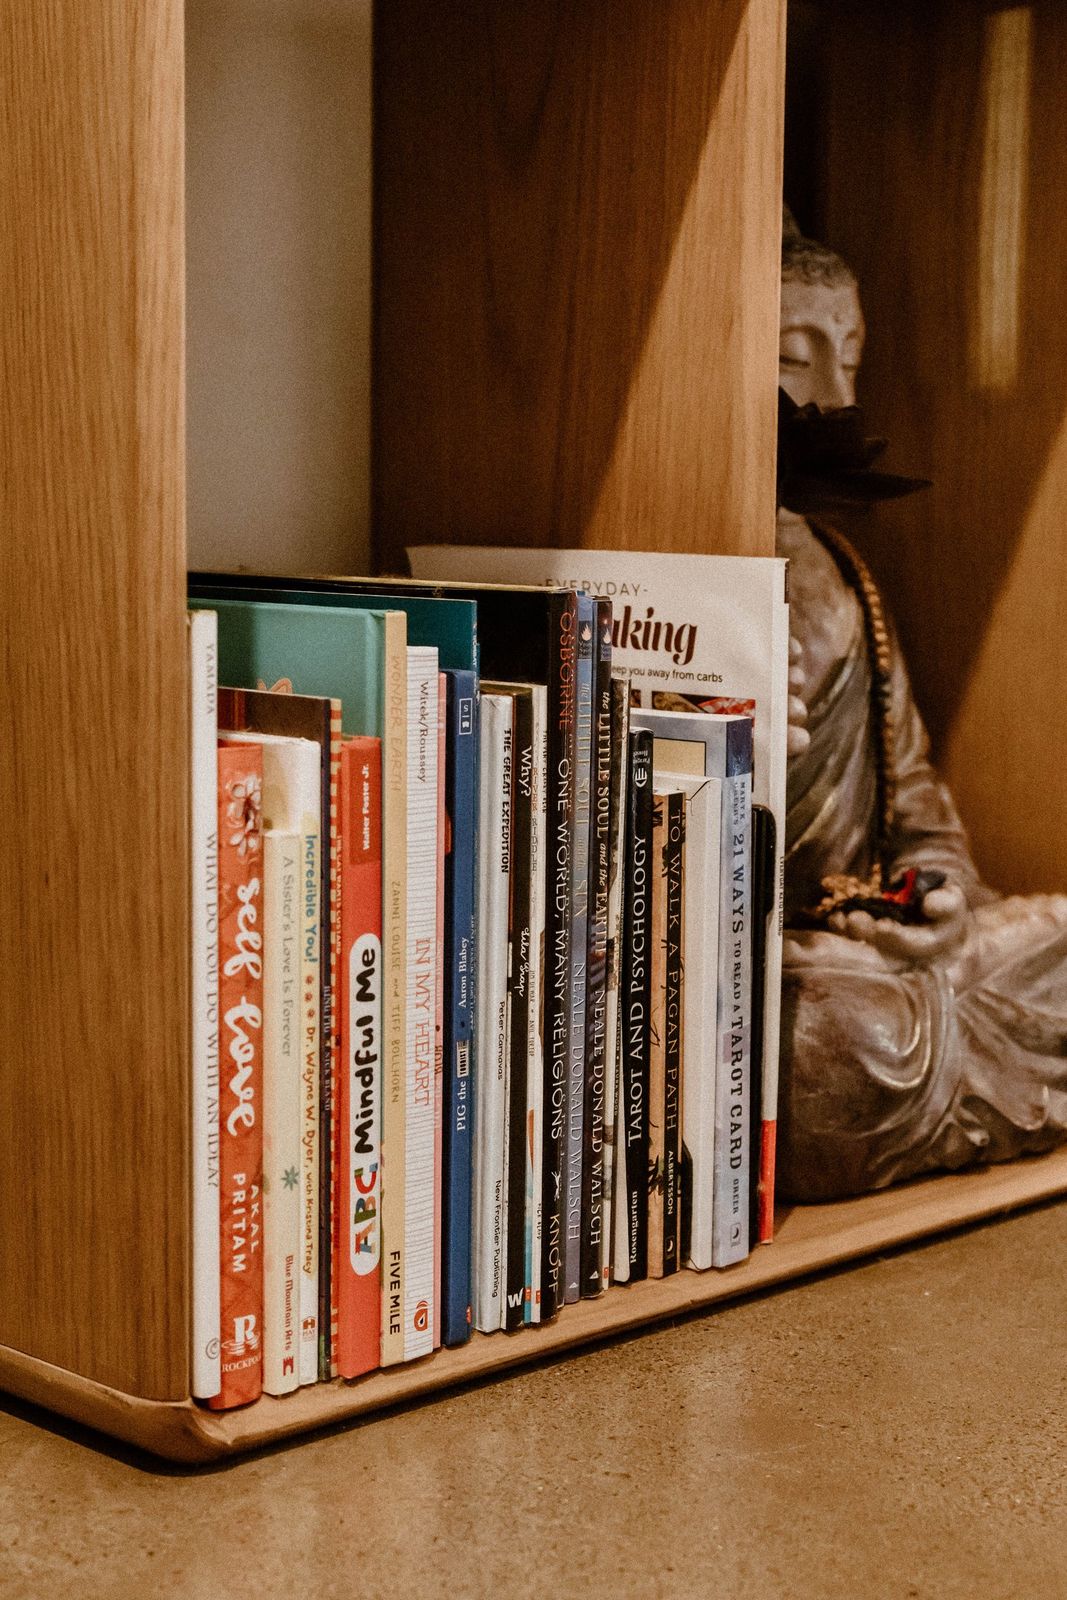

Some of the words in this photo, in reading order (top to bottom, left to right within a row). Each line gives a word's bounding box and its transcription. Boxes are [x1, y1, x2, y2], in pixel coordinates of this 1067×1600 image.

[612, 605, 698, 666] king
[206, 643, 215, 715] YAMADA
[391, 656, 401, 728] WONDER
[560, 611, 574, 730] OSBORNE
[611, 666, 626, 676] eep
[629, 668, 645, 676] you
[647, 669, 671, 680] away
[672, 669, 694, 680] from
[697, 673, 723, 683] carbs
[602, 691, 610, 710] the
[417, 681, 429, 783] Witek/Roussey
[503, 727, 512, 751] THE
[598, 713, 610, 781] LITTLE
[361, 763, 369, 779] Jr.
[391, 737, 401, 792] EARTH
[503, 756, 511, 796] GREAT
[518, 745, 532, 797] Why?
[557, 759, 570, 811] ONE
[362, 781, 370, 814] Foster
[597, 786, 610, 838] SOUL
[362, 815, 370, 850] Walter
[501, 802, 510, 873] EXPEDITION
[530, 818, 538, 872] RIDDLE
[670, 809, 681, 842] TO
[733, 833, 744, 857] 21
[206, 832, 218, 891] WHAT
[283, 856, 294, 868] A
[305, 834, 318, 918] Incredible
[555, 820, 569, 918] WORLD,
[599, 868, 608, 886] the
[600, 843, 608, 866] and
[282, 874, 295, 931] Sister's
[631, 835, 646, 994] PSYCHOLOGY
[669, 854, 680, 928] WALK
[732, 865, 744, 934] WAYS
[206, 903, 218, 933] DO
[223, 877, 262, 980] self
[304, 924, 318, 964] You!
[595, 892, 608, 953] EARTH
[206, 944, 219, 983] YOU
[282, 936, 293, 974] Love
[356, 948, 376, 1002] Me
[416, 938, 431, 965] IN
[458, 937, 470, 973] Blabey
[554, 930, 568, 1001] MANY
[669, 943, 678, 957] A
[734, 940, 742, 958] TO
[206, 992, 218, 1023] DO
[283, 979, 293, 994] Is
[416, 972, 431, 1010] MY
[458, 976, 467, 1008] Aaron
[572, 962, 587, 1035] NEALE
[733, 965, 741, 1000] READ
[733, 1004, 741, 1013] A
[281, 999, 293, 1057] Forever
[305, 1027, 316, 1048] Dr.
[593, 990, 605, 1057] NEALE
[629, 1002, 644, 1060] AND
[668, 971, 679, 1054] PAGAN
[207, 1034, 219, 1089] WITH
[223, 995, 262, 1137] love
[302, 1051, 316, 1100] Wayne
[415, 1023, 430, 1106] HEART
[497, 1033, 505, 1081] Carnavas
[551, 1012, 567, 1140] RELIGIONS
[730, 1016, 743, 1096] TAROT
[354, 1014, 378, 1154] Mindful
[459, 1080, 467, 1100] the
[570, 1045, 584, 1141] DONALD
[591, 1065, 604, 1153] DONALD
[628, 1069, 643, 1147] TAROT
[667, 1069, 678, 1129] PATH
[207, 1098, 219, 1125] AN
[305, 1105, 316, 1126] W.
[456, 1104, 466, 1131] PIG
[730, 1105, 743, 1170] CARD
[305, 1172, 314, 1197] with
[354, 1162, 378, 1255] ABC
[568, 1150, 582, 1240] WALSCH
[590, 1161, 602, 1246] WALSCH
[732, 1178, 740, 1215] GREER
[232, 1173, 247, 1273] PRITAM
[250, 1184, 260, 1254] AKAL
[305, 1198, 314, 1240] Kristina
[493, 1203, 501, 1246] Frontier
[629, 1190, 638, 1264] Rosengarten
[284, 1254, 294, 1278] Blue
[302, 1242, 314, 1274] Tracy
[390, 1251, 400, 1291] FIVE
[491, 1249, 500, 1298] Publishing
[548, 1213, 561, 1292] KNOPF
[284, 1280, 294, 1328] Mountain
[390, 1295, 400, 1335] MILE
[284, 1330, 294, 1351] Arts
